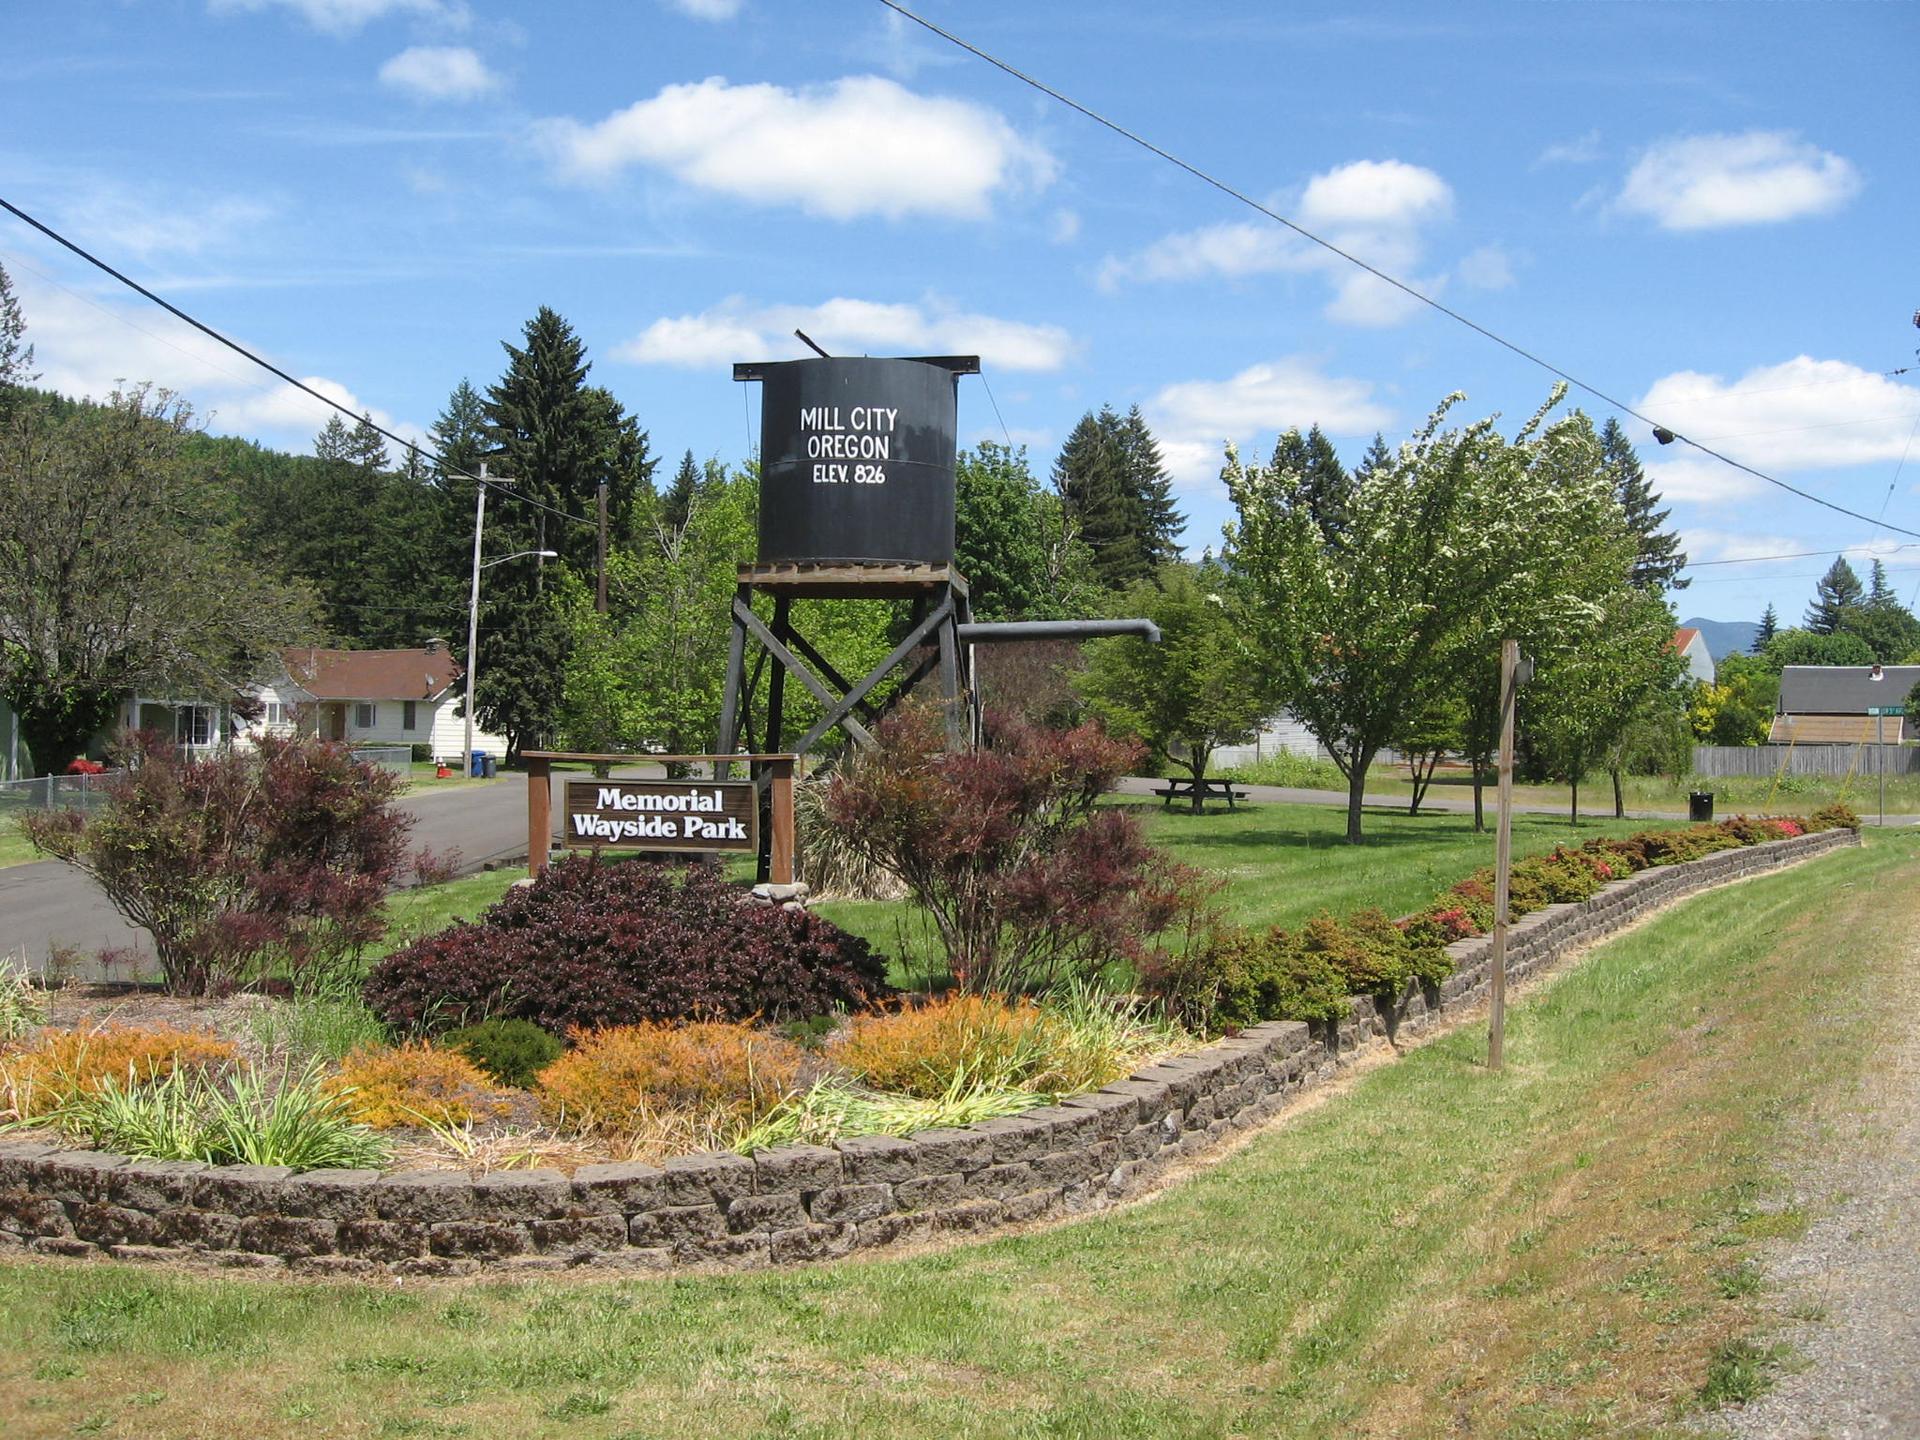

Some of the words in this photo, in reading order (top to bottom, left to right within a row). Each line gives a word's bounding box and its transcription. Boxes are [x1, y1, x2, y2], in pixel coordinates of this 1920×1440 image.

[801, 407, 845, 431] MILL
[851, 407, 898, 431] CITY
[808, 435, 889, 459] OREGON
[813, 464, 849, 483] ELEV.
[854, 464, 886, 484] 826
[596, 788, 724, 812] Memorial
[573, 814, 677, 842] Wayside
[683, 816, 748, 839] Park
